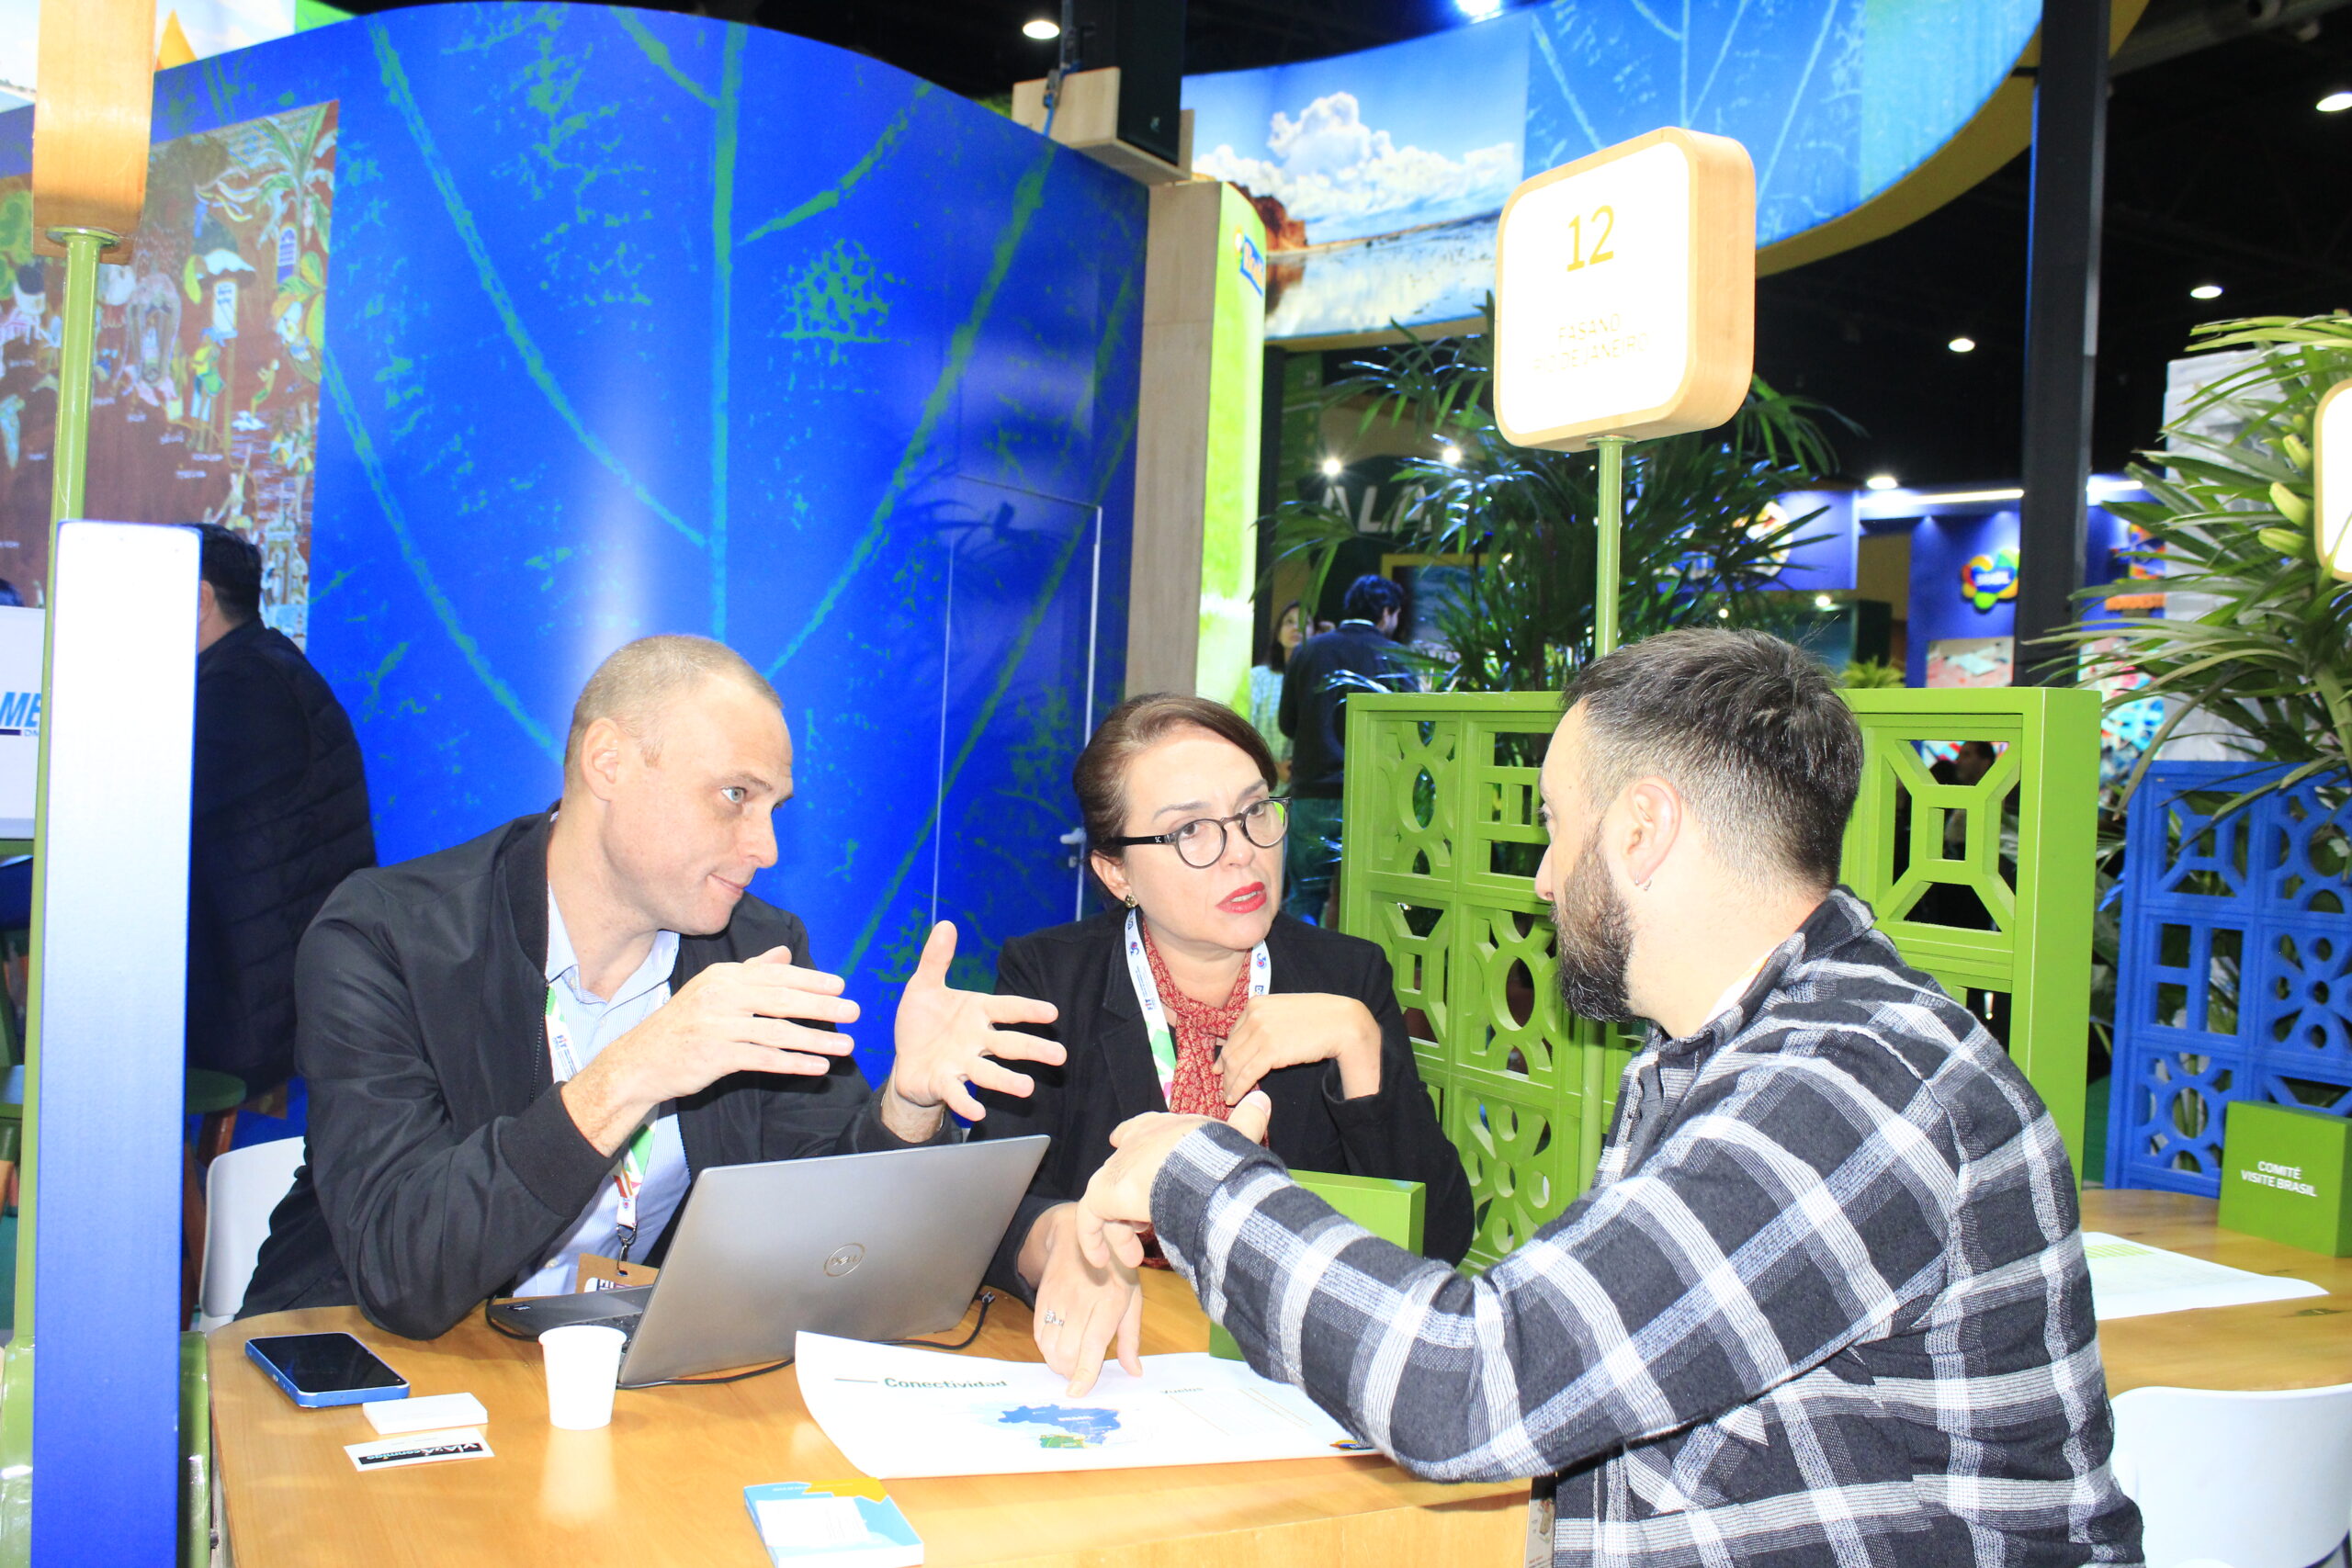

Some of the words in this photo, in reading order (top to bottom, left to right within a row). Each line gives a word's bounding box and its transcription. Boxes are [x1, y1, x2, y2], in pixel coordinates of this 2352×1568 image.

[1566, 205, 1614, 272] 12
[1558, 312, 1621, 346] FASANO
[1560, 348, 1579, 371] DE
[1582, 332, 1648, 367] JANEIRO
[2240, 1169, 2276, 1188] VISITE
[2276, 1178, 2318, 1197] BRASIL
[2257, 1160, 2301, 1180] COMITÉ
[831, 1256, 859, 1266] DELL
[884, 1377, 1008, 1388] Conectividad
